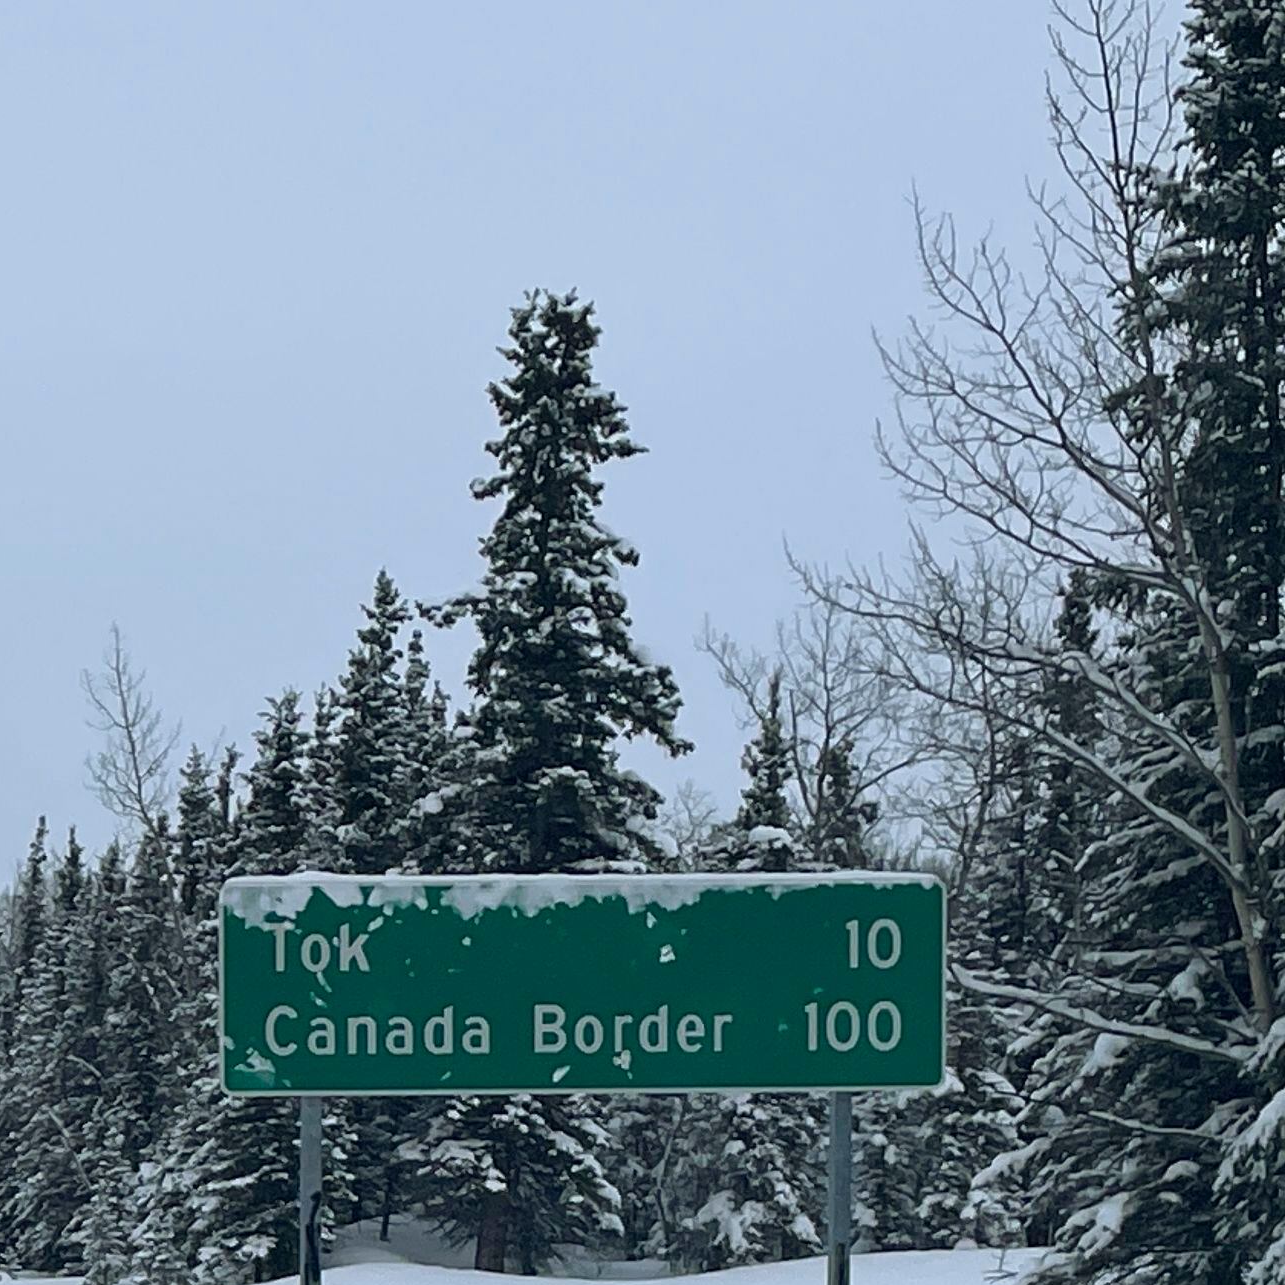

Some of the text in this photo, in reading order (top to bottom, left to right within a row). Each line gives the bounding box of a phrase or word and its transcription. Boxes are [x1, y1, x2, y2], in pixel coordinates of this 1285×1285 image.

[270, 918, 903, 973] Tok 10
[264, 1001, 904, 1057] Canada Border 100
